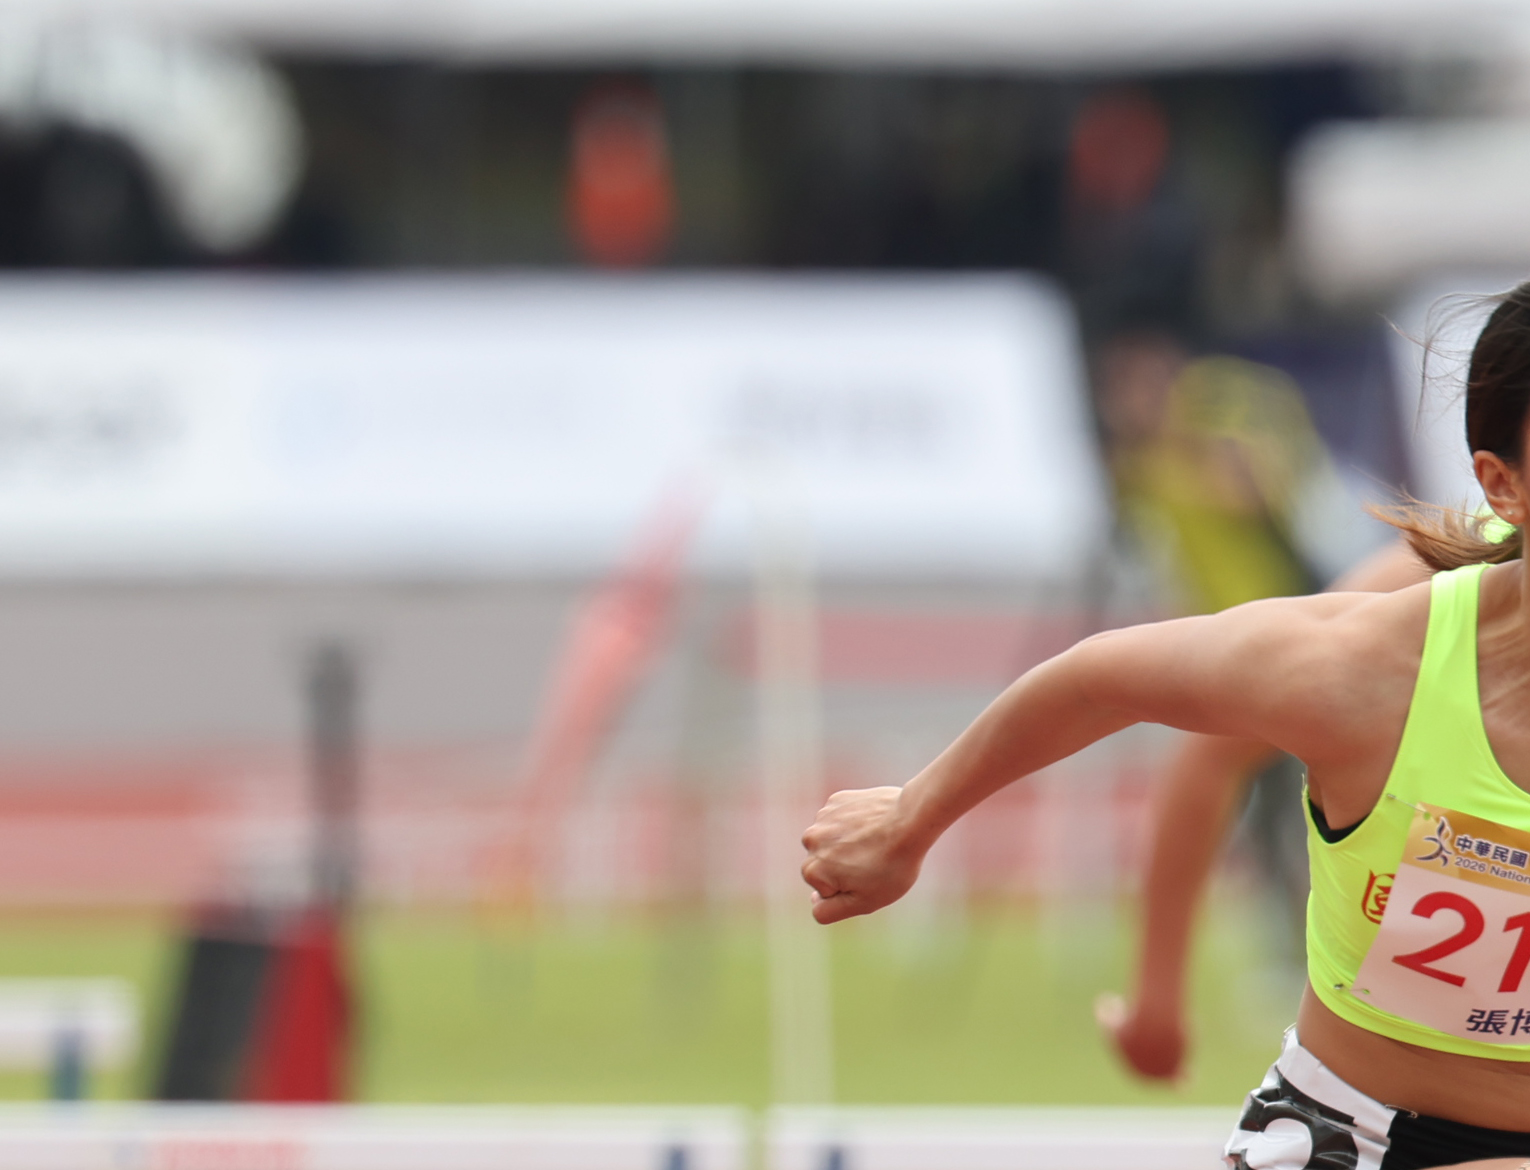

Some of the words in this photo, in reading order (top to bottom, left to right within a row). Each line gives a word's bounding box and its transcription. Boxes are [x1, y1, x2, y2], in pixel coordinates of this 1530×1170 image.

[1455, 836, 1528, 869] 中華民國
[1455, 856, 1487, 873] 2026
